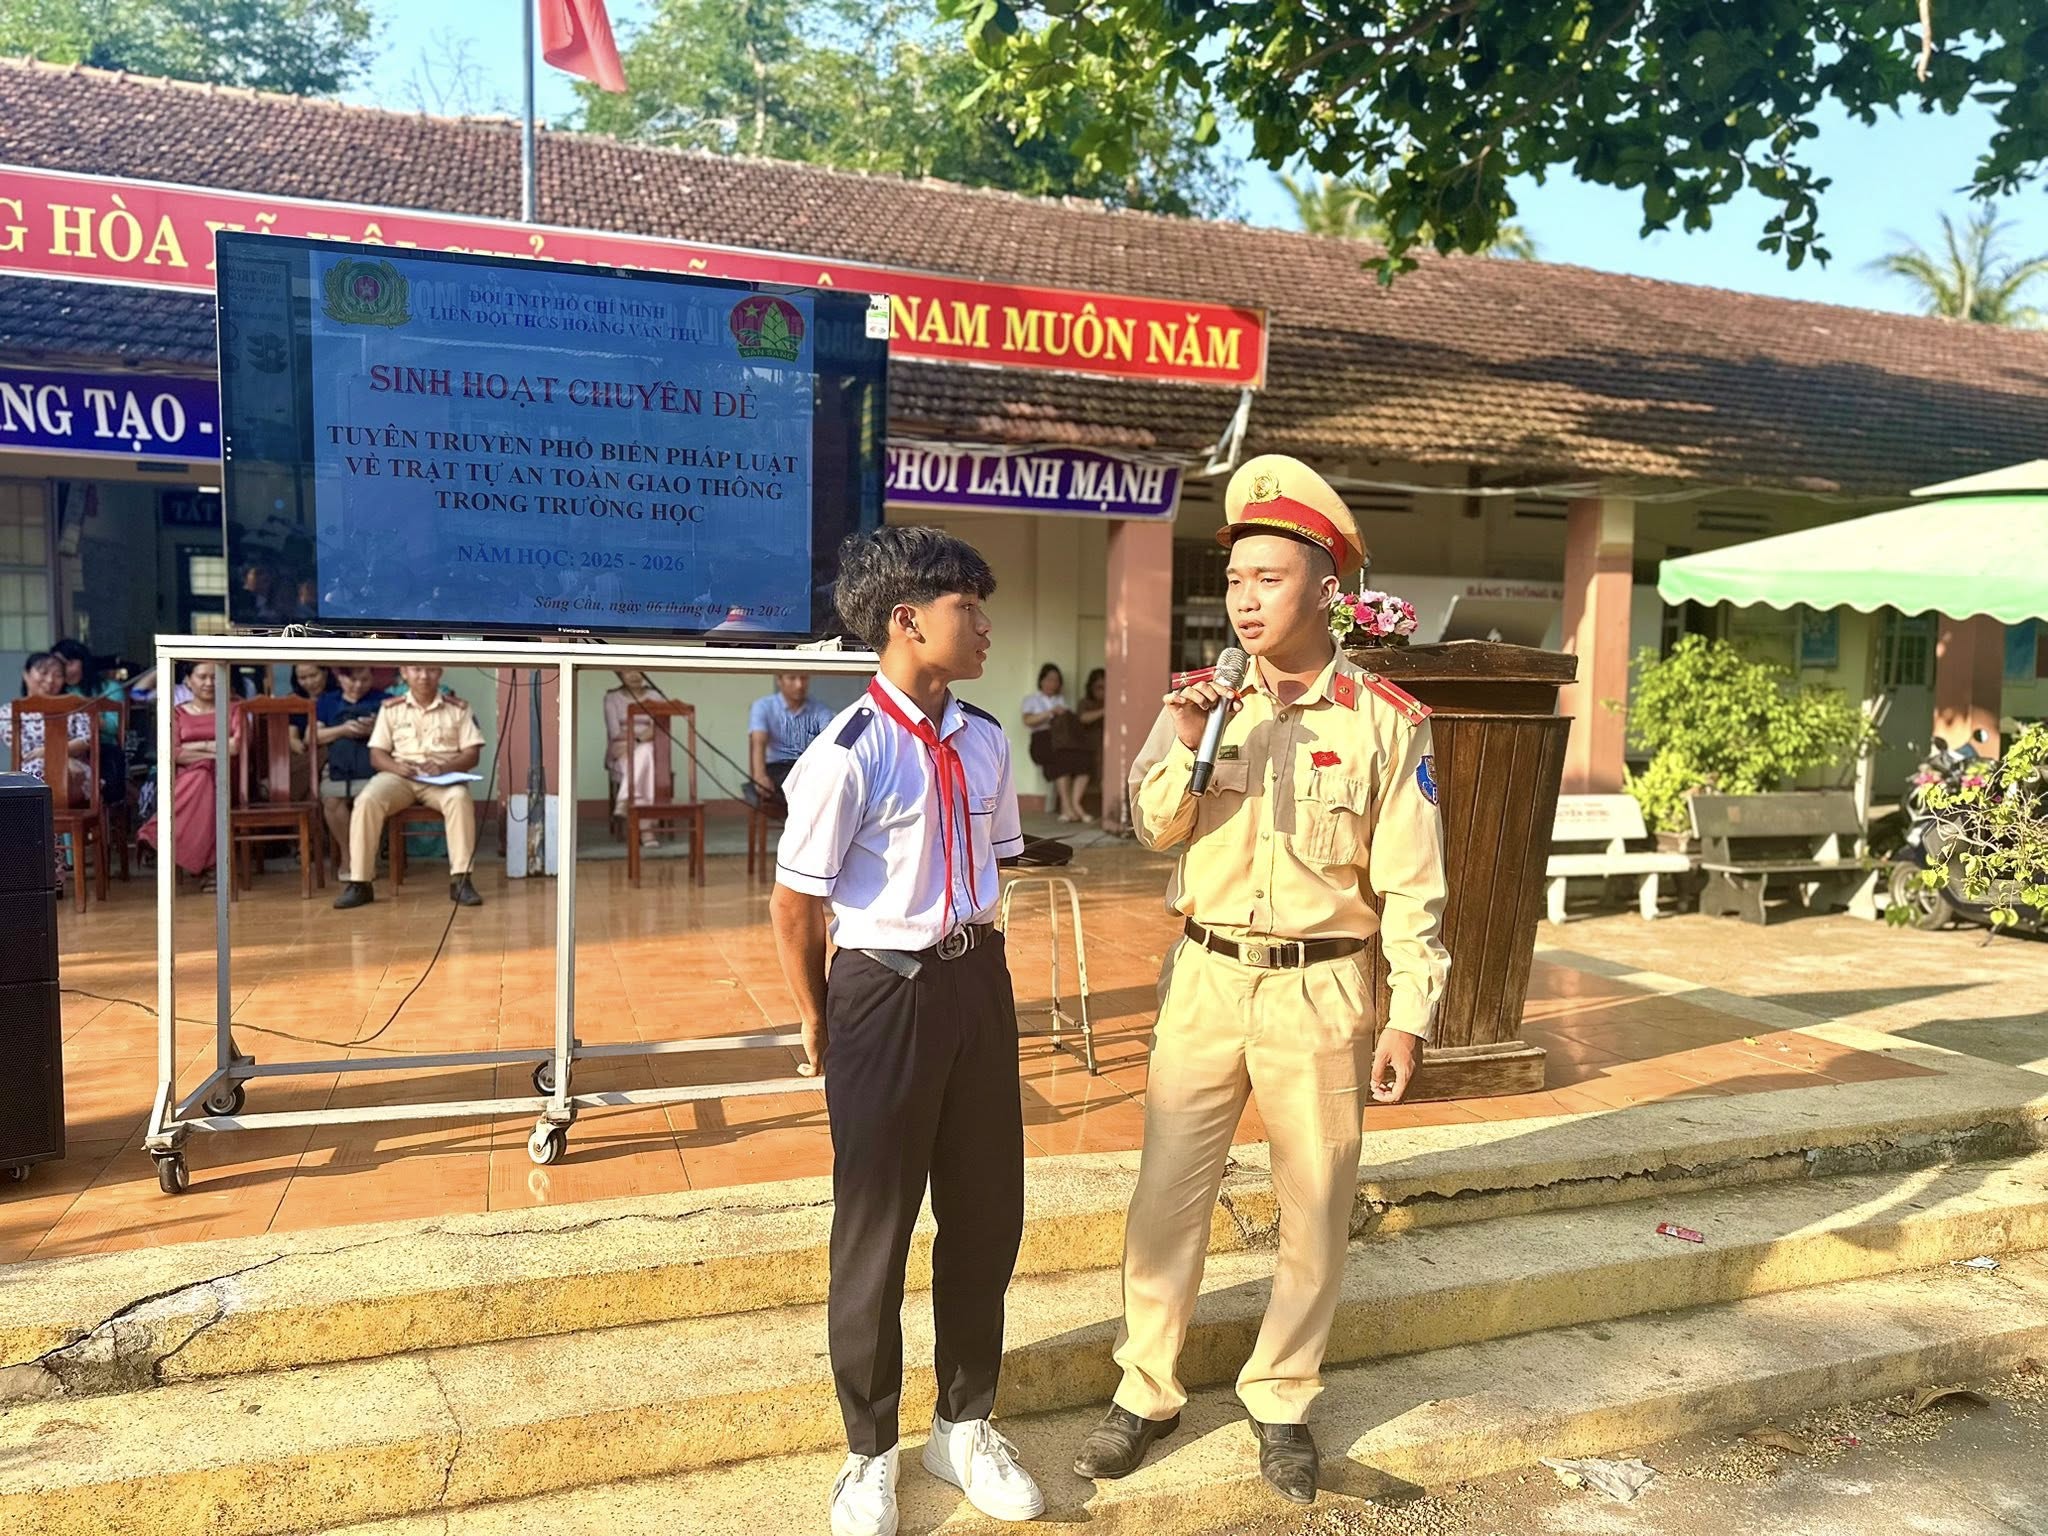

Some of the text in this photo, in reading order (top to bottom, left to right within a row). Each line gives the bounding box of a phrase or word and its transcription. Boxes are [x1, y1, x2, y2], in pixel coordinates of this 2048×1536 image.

[47, 193, 189, 268] HÒA
[429, 304, 471, 321] LIÊN
[513, 313, 559, 329] THCS
[562, 317, 624, 335] HOÀNG
[505, 292, 551, 309] TNTP
[583, 299, 614, 315] CHÍ
[619, 303, 665, 320] MINH
[890, 294, 991, 349] NAM
[1002, 302, 1136, 361] MUÔN
[1145, 313, 1242, 370] NĂM
[369, 364, 759, 420] SINH HOẠT CHUYÊN ĐỀ
[83, 387, 186, 452] TẠO
[327, 423, 418, 449] TUYÊN
[424, 431, 533, 455] TRUYỀN
[539, 436, 593, 459] PHỔ
[665, 444, 731, 469] PHÁP
[735, 452, 799, 476] LUẬT
[345, 452, 784, 500] VỀ TRẬT TỰ AN TOÀN GIAO THÔNG
[1067, 459, 1168, 511] MẠNH
[434, 490, 705, 526] TRONG TRƯỜNG HỌC
[457, 542, 512, 564] NĂM
[517, 548, 574, 570] HỌC:
[580, 551, 624, 569] 2025
[642, 554, 685, 571] 2026
[533, 595, 570, 612] Sông
[609, 599, 641, 614] ngày
[646, 600, 662, 613] 06
[666, 600, 703, 617] tháng
[706, 603, 722, 615] 04
[758, 604, 788, 617] 2026
